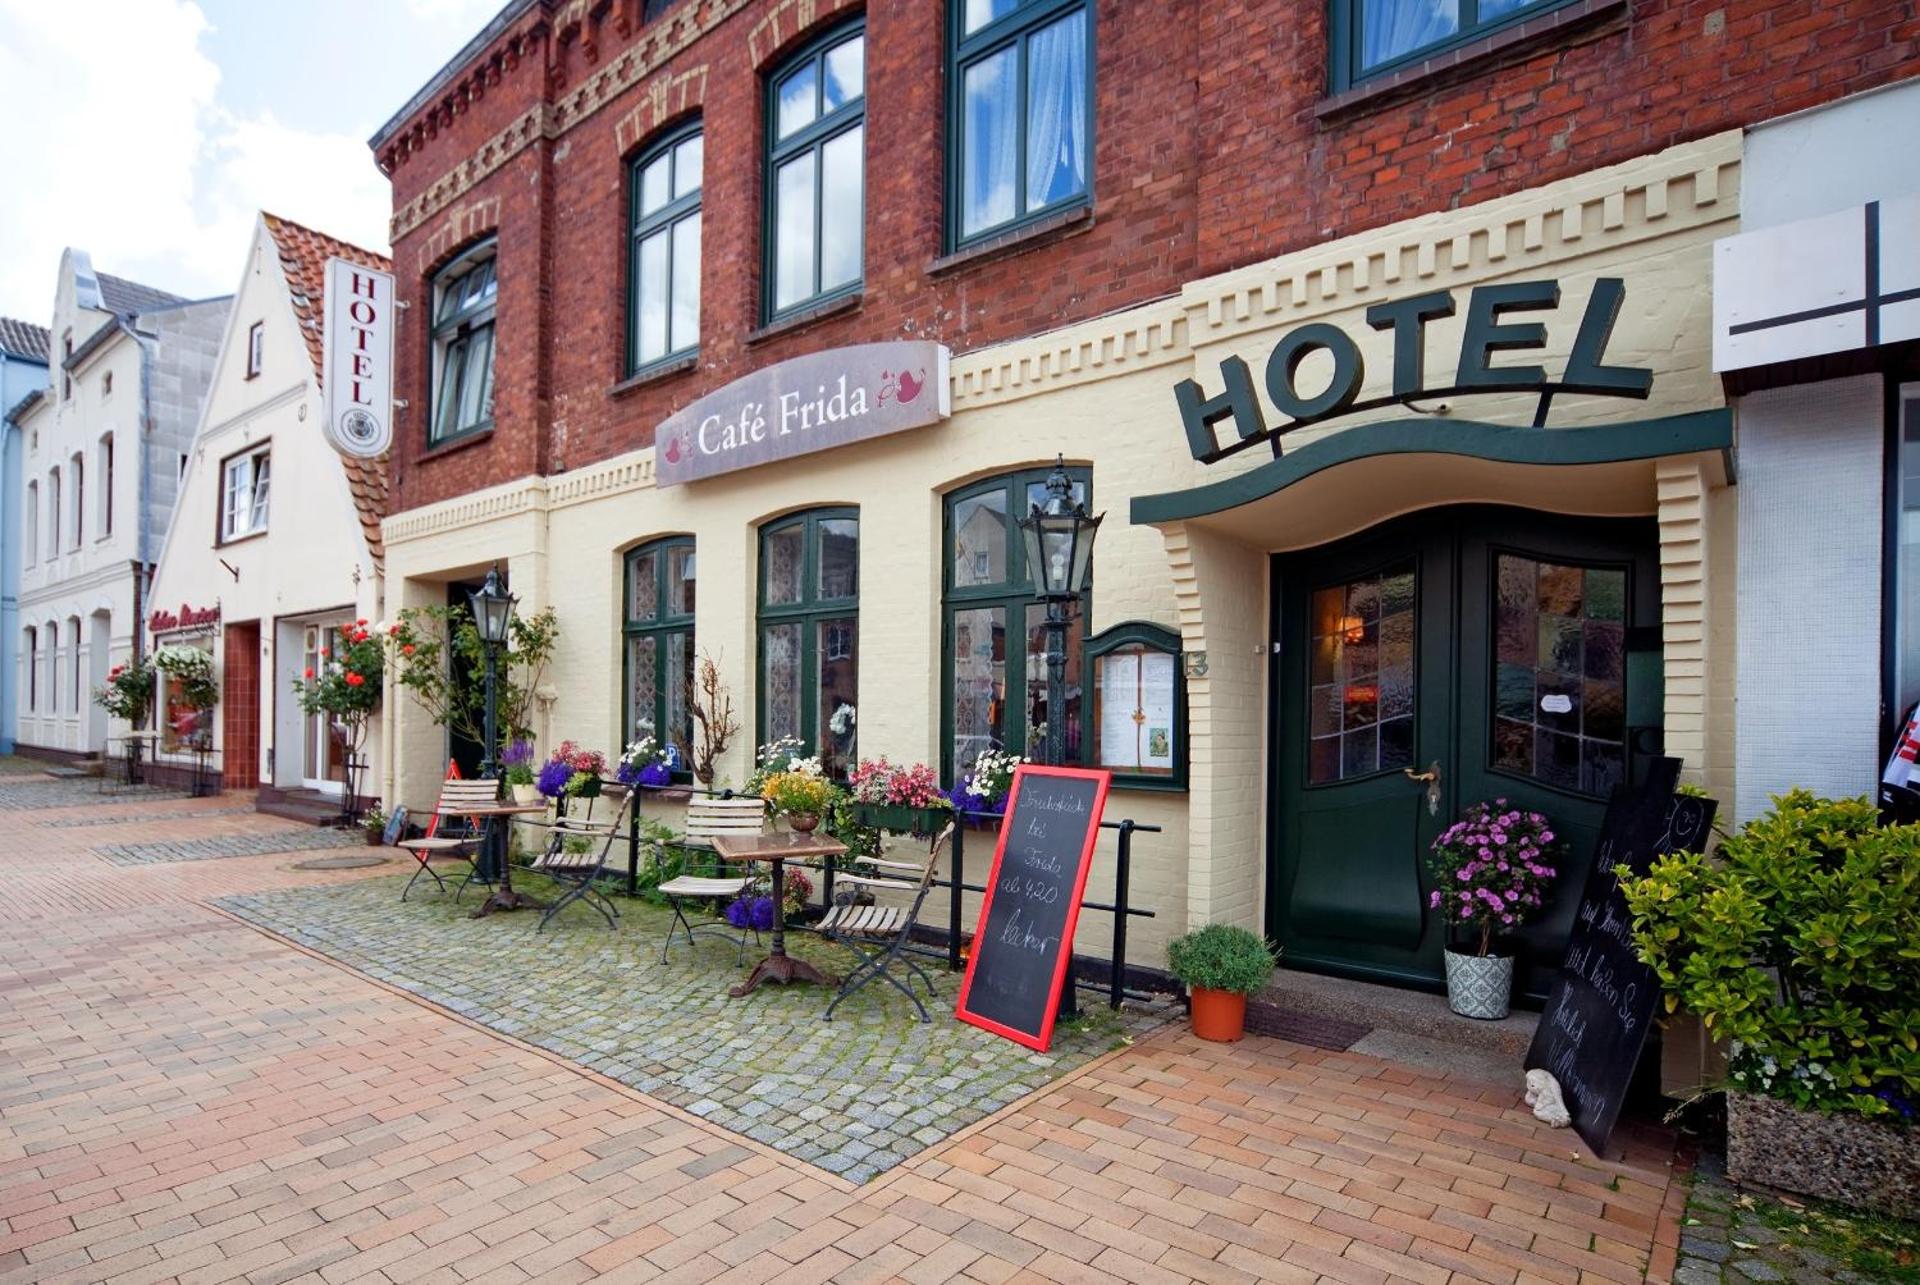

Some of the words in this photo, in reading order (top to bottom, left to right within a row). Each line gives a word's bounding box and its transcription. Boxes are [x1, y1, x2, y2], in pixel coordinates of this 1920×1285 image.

[350, 273, 376, 406] HOTEL
[1174, 277, 1654, 465] HOTEL
[698, 402, 767, 455] Café
[778, 374, 869, 436] Frida
[1000, 876, 1020, 894] ab
[1025, 878, 1060, 904] 4,20
[1000, 908, 1060, 956] lecker
